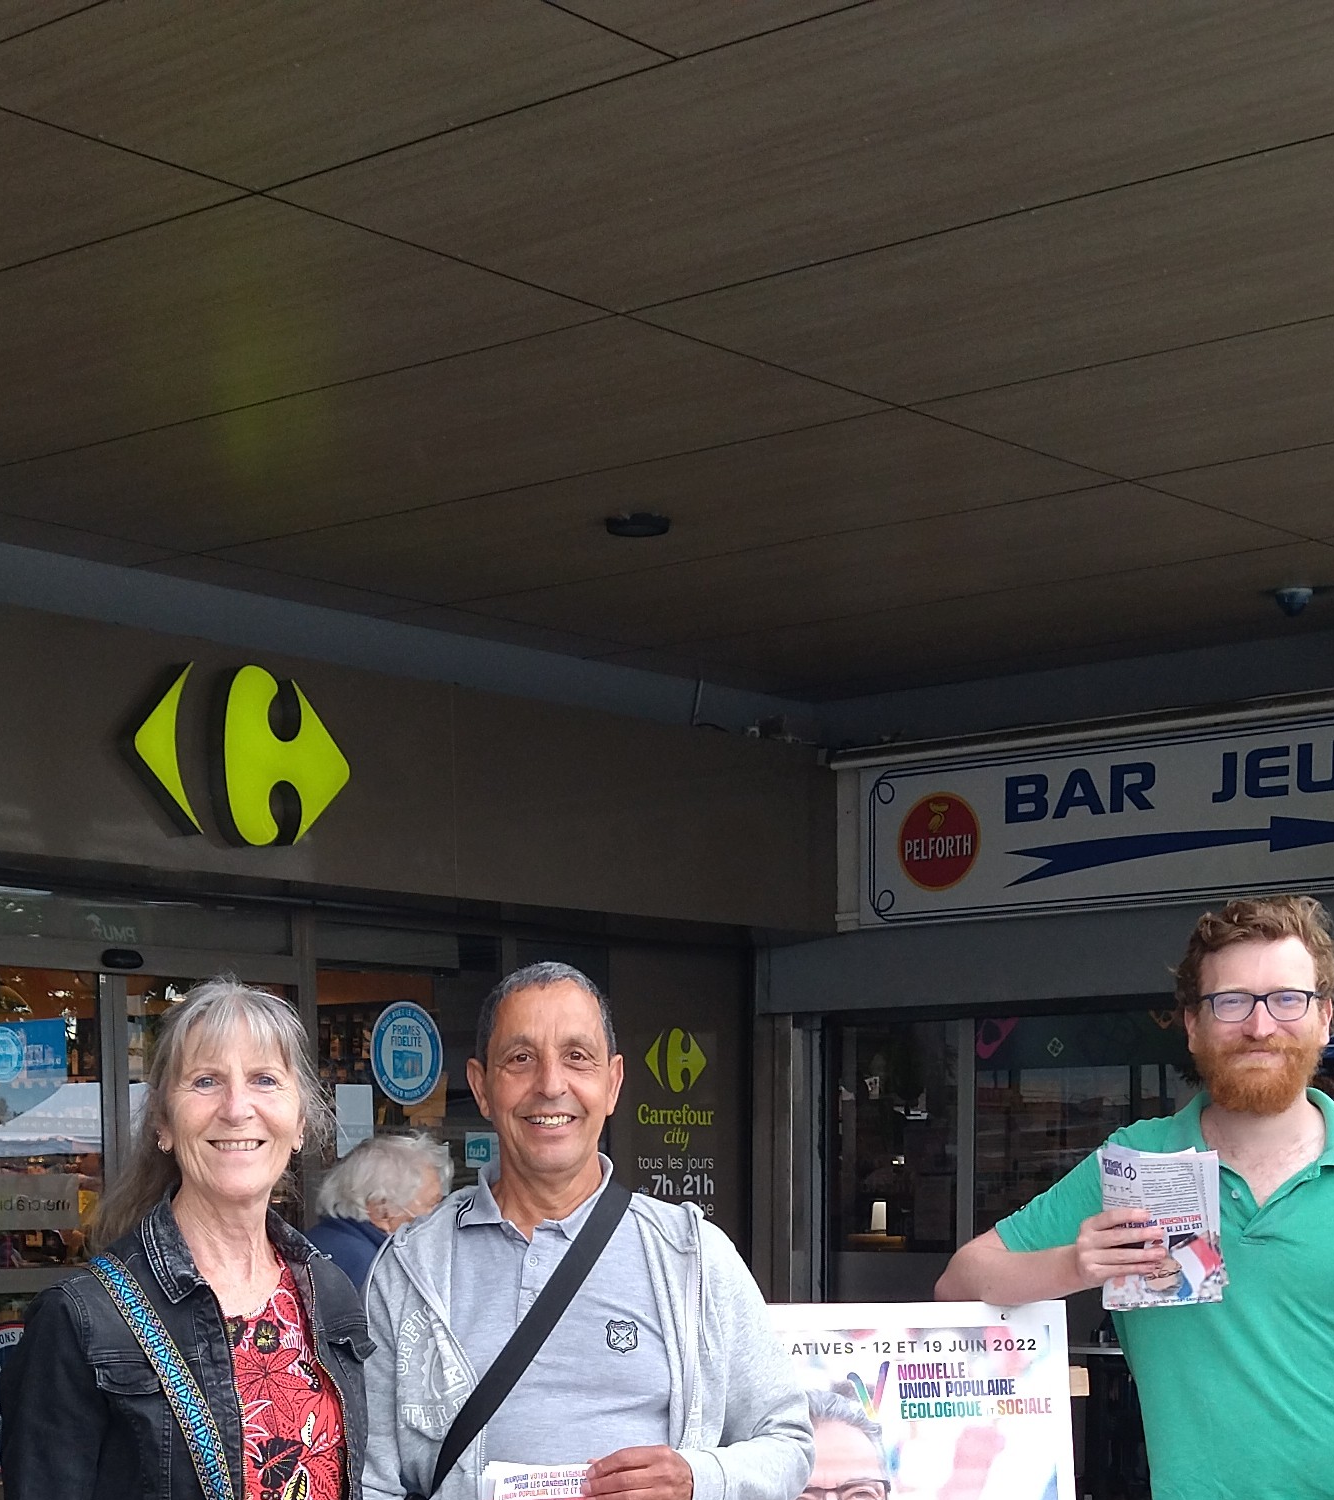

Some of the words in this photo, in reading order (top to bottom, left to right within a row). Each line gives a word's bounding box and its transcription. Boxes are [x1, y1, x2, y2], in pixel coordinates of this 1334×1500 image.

[1005, 761, 1156, 824] BAR
[904, 834, 973, 862] PELFORTH
[392, 1024, 421, 1036] PRIMES
[391, 1035, 423, 1048] FIDELITE
[637, 1103, 714, 1125] Carrefour
[663, 1126, 690, 1151] city
[468, 1145, 487, 1158] tub
[638, 1155, 663, 1169] tous
[667, 1154, 683, 1169] les
[685, 1154, 714, 1173] jours
[651, 1173, 673, 1196] 7h
[675, 1183, 681, 1195] à
[682, 1173, 714, 1196] 21h
[1192, 1223, 1203, 1231] LES
[789, 1342, 855, 1356] ATIVES
[872, 1341, 892, 1354] 12
[897, 1341, 917, 1354] ET
[923, 1340, 943, 1353] 19
[948, 1339, 987, 1352] JUIN
[993, 1338, 1037, 1351] 2022
[897, 1362, 966, 1381] NOUVELLE
[899, 1380, 940, 1399] UNION
[945, 1378, 1016, 1398] POPULAIRE
[901, 1399, 983, 1420] ÉCOLOGIQUE
[997, 1397, 1052, 1415] SOCIALE
[530, 1472, 547, 1480] VOTER
[530, 1480, 540, 1488] LES
[551, 1487, 560, 1495] LES
